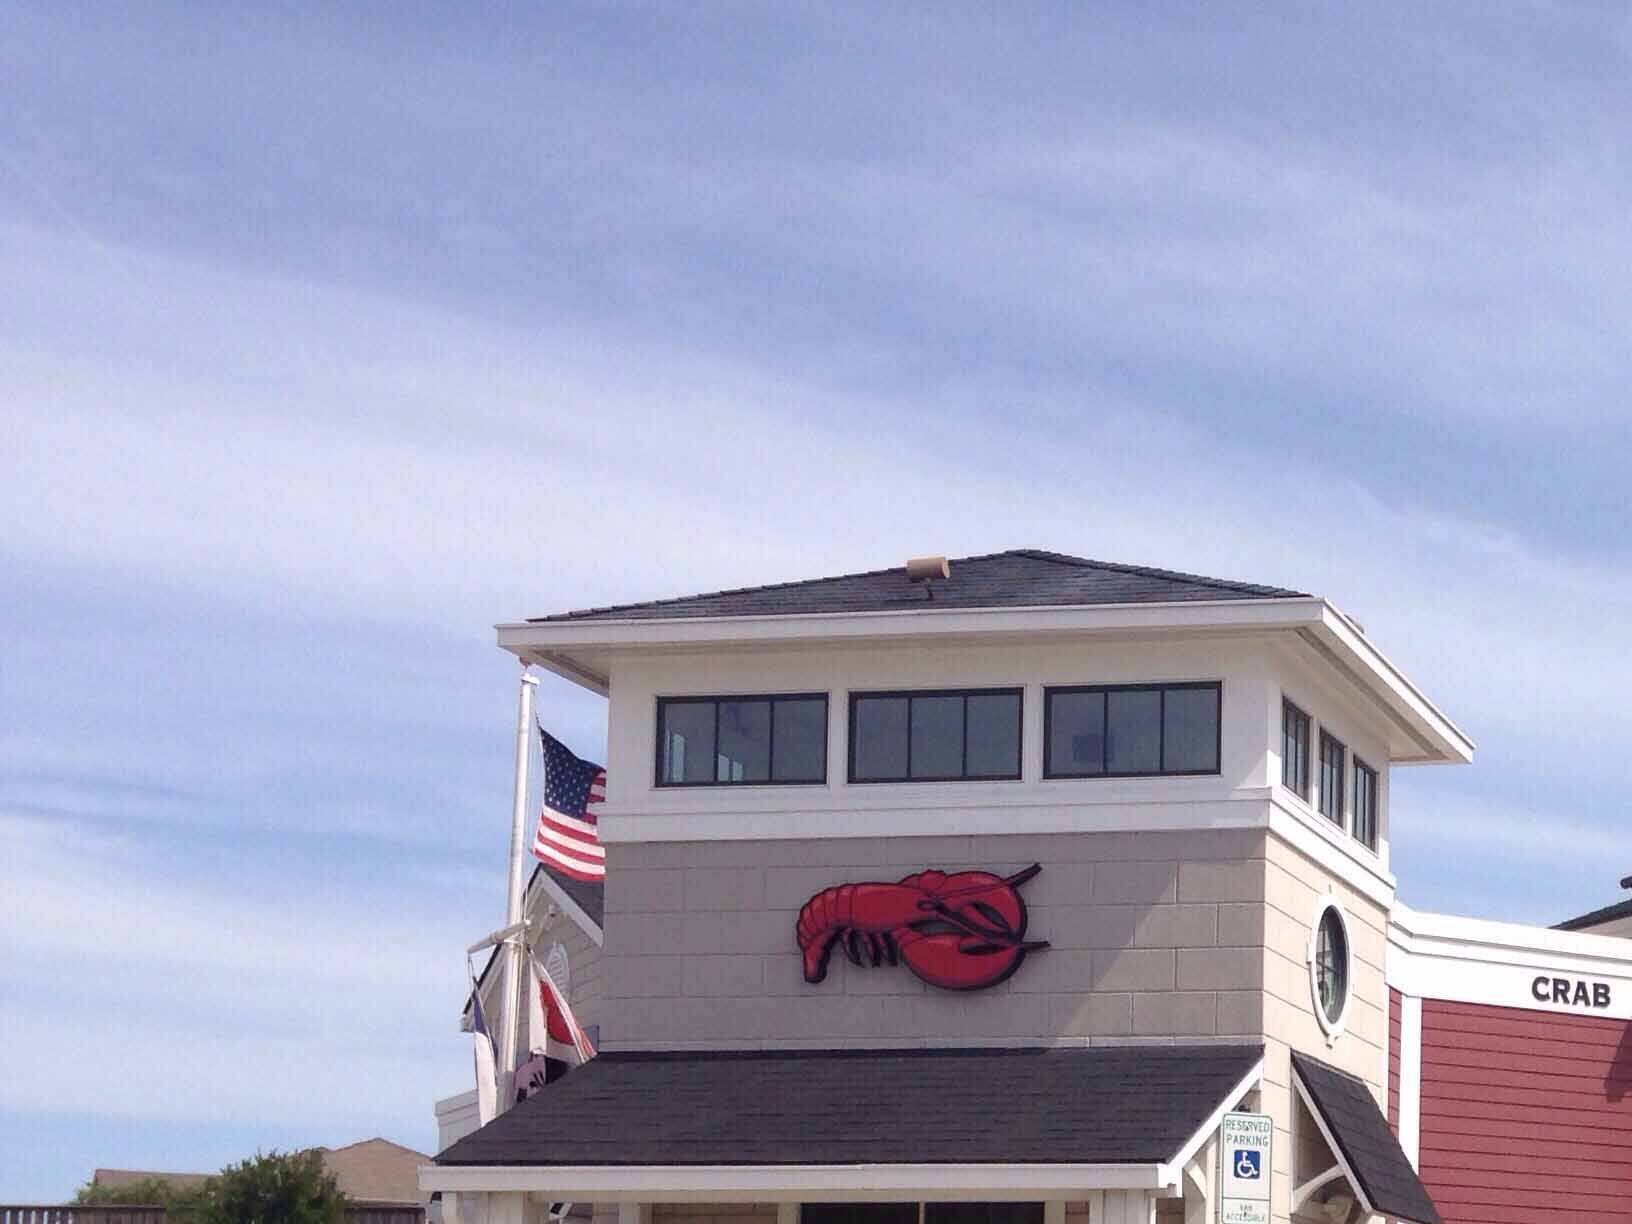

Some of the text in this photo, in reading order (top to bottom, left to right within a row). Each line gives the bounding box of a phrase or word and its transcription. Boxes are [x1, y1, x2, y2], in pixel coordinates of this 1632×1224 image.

[1532, 976, 1611, 1008] CRAB
[1225, 1119, 1269, 1132] RESERVED
[1226, 1134, 1268, 1147] PARKING
